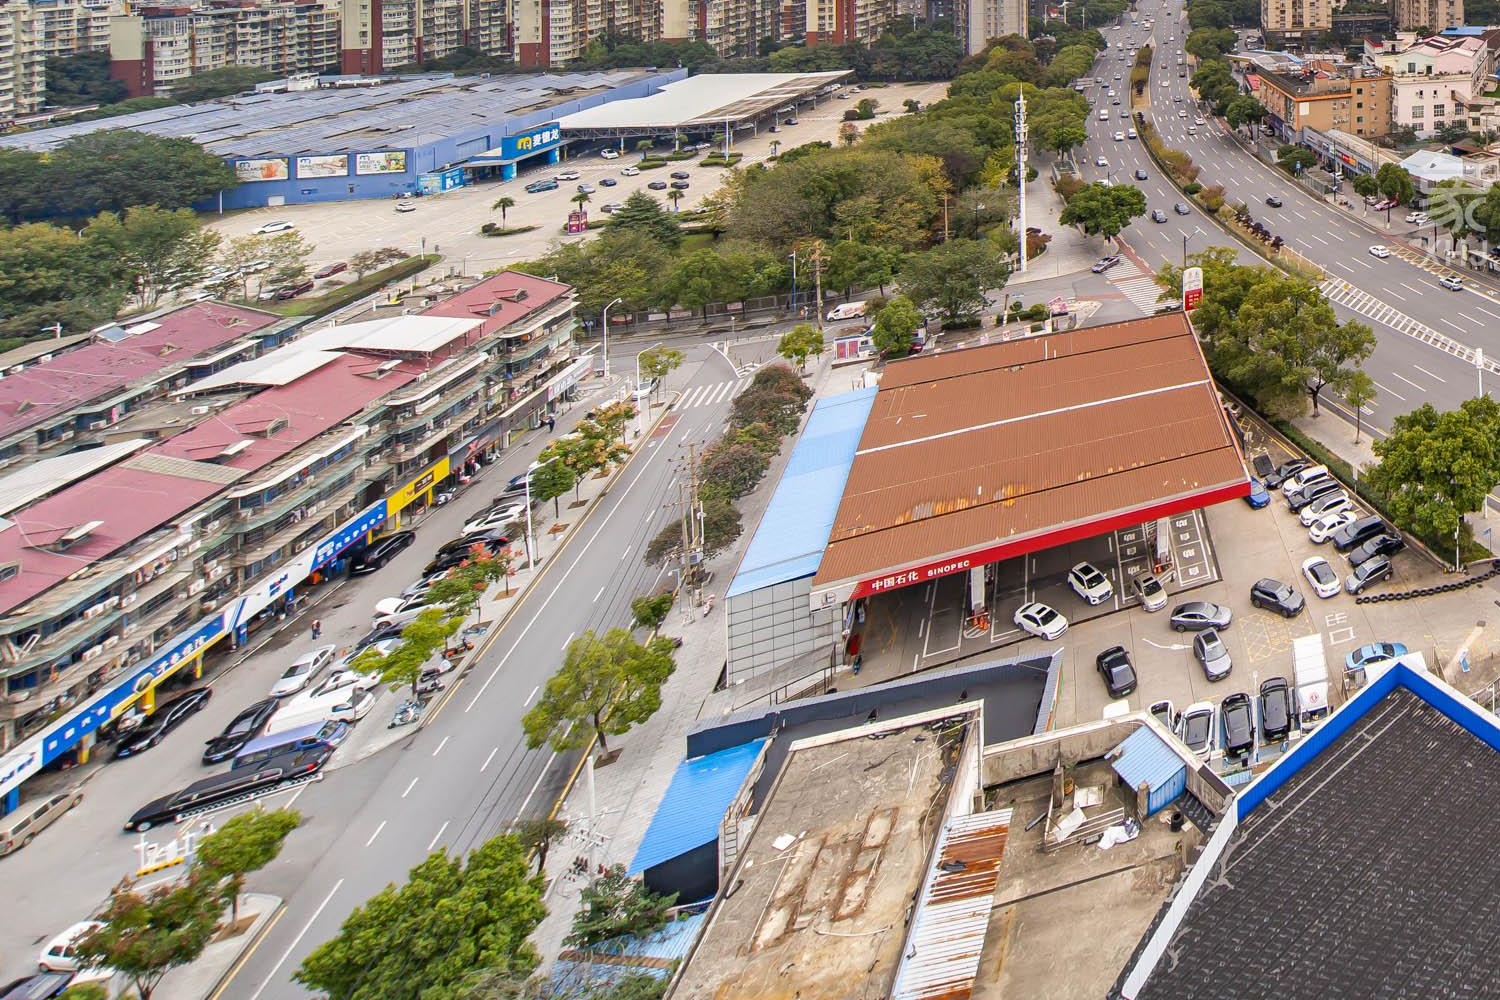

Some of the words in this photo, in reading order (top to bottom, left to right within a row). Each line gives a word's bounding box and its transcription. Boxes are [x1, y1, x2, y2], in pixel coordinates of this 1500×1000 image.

[927, 559, 970, 577] SINOPEC
[871, 570, 919, 591] 中国石化
